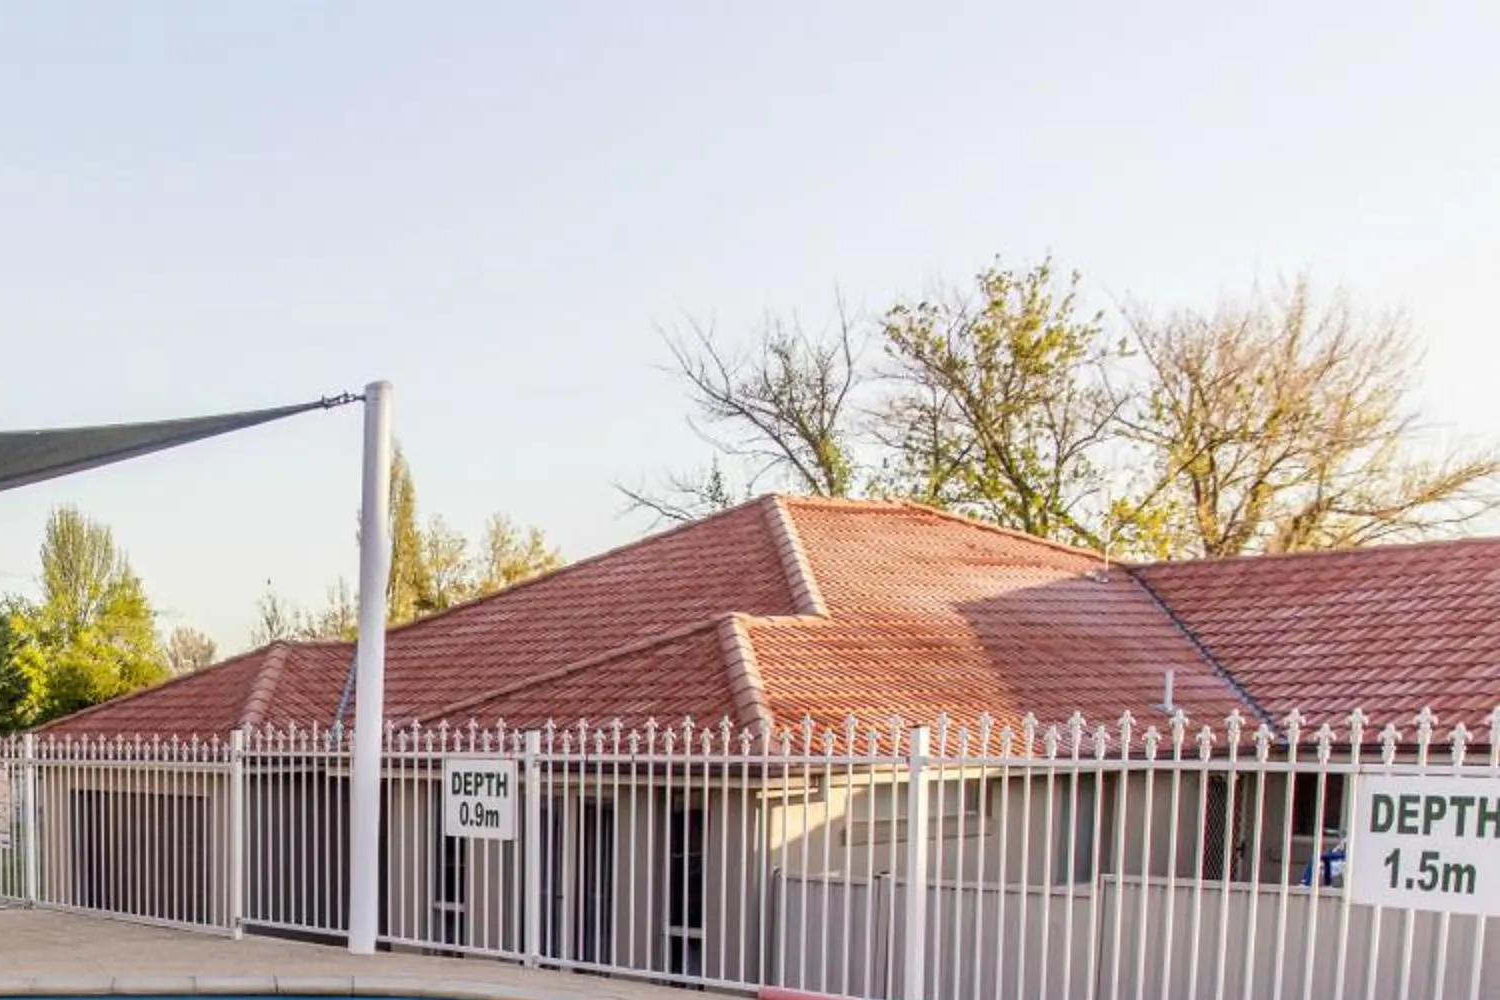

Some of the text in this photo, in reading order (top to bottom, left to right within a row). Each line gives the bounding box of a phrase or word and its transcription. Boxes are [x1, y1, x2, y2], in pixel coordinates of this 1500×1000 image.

[451, 771, 508, 797] DEPTH
[459, 801, 499, 828] 0.9m
[1370, 793, 1500, 838] DEPTH
[1384, 848, 1477, 894] 1.5m
